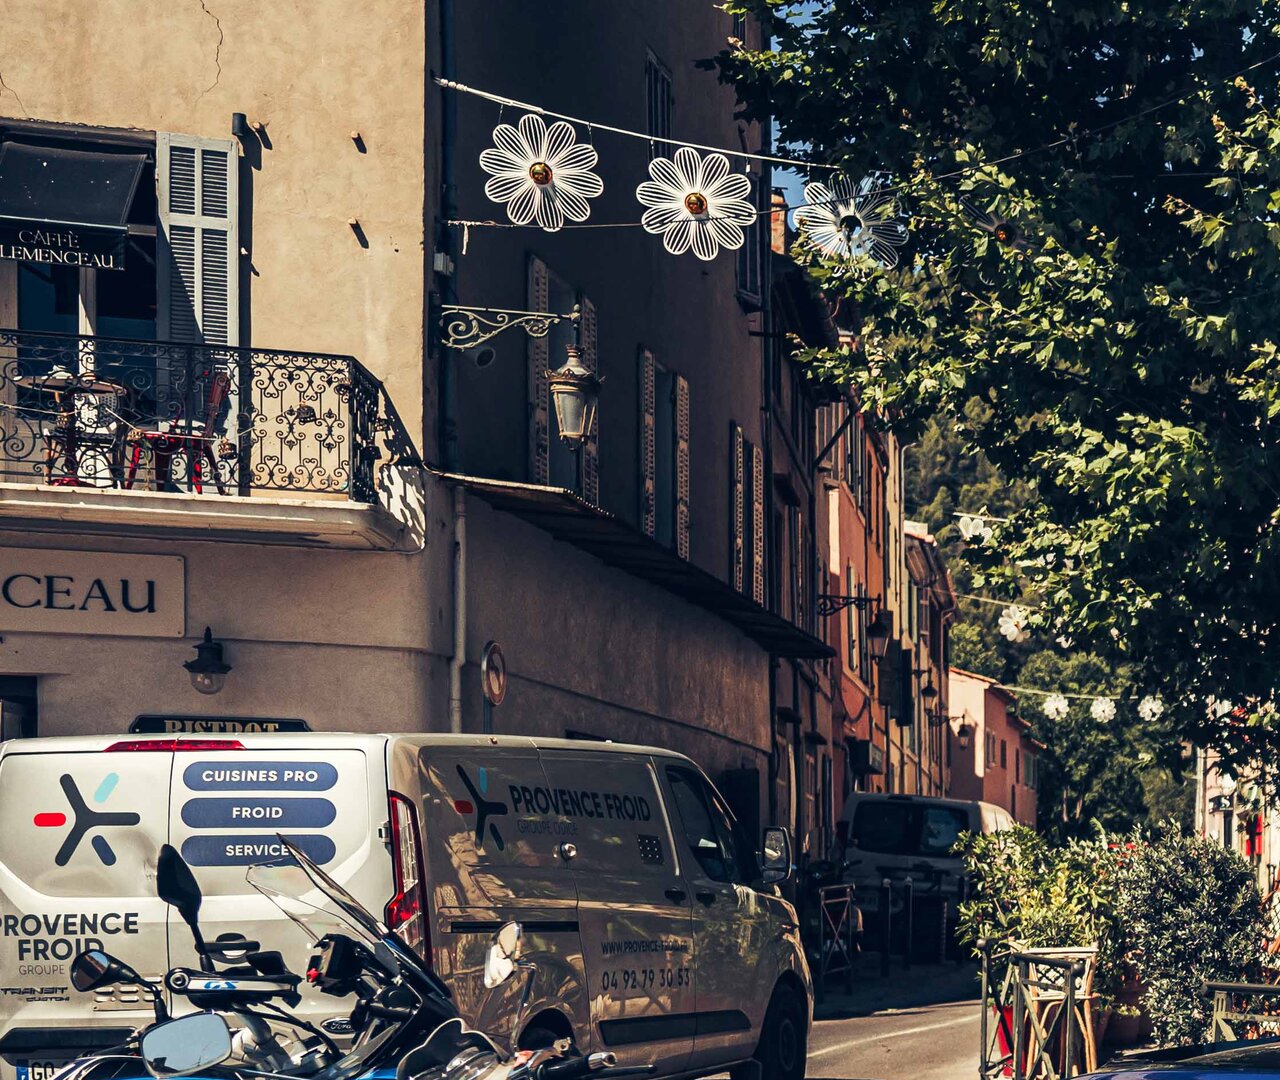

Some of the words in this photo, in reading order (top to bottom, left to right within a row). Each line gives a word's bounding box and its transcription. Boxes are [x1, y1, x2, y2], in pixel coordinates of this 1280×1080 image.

[2, 574, 157, 613] CEAU
[202, 770, 278, 782] CUISINES
[283, 770, 318, 782] PRO
[508, 784, 604, 819] PROVENCE
[603, 793, 651, 821] FROID
[232, 807, 283, 819] FROID
[517, 819, 552, 835] GROUPE
[0, 912, 139, 936] ROVENCE
[18, 964, 65, 976] GROUPE
[602, 970, 618, 991] 04
[623, 969, 637, 990] 92
[641, 968, 655, 989] 79
[659, 968, 673, 987] 30
[677, 967, 690, 986] 53
[0, 986, 68, 995] TRANSIT
